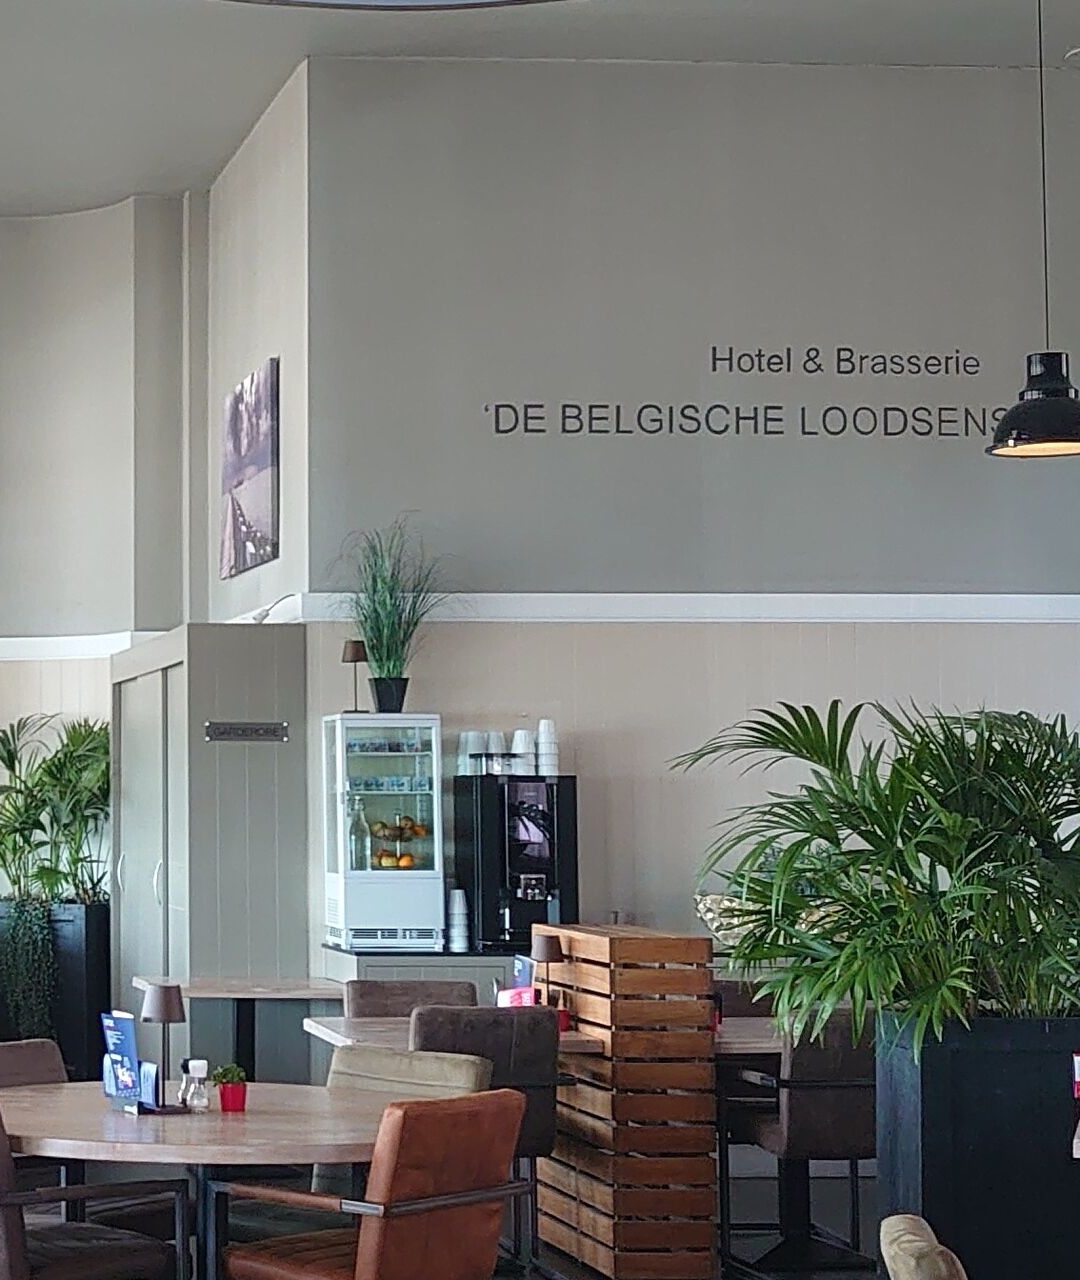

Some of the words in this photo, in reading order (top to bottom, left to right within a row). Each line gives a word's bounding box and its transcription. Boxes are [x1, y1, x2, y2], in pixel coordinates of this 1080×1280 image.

[711, 346, 792, 373] Hotel
[802, 347, 824, 374] &
[836, 347, 980, 375] Brasserie
[561, 404, 784, 436] BELGISCHE
